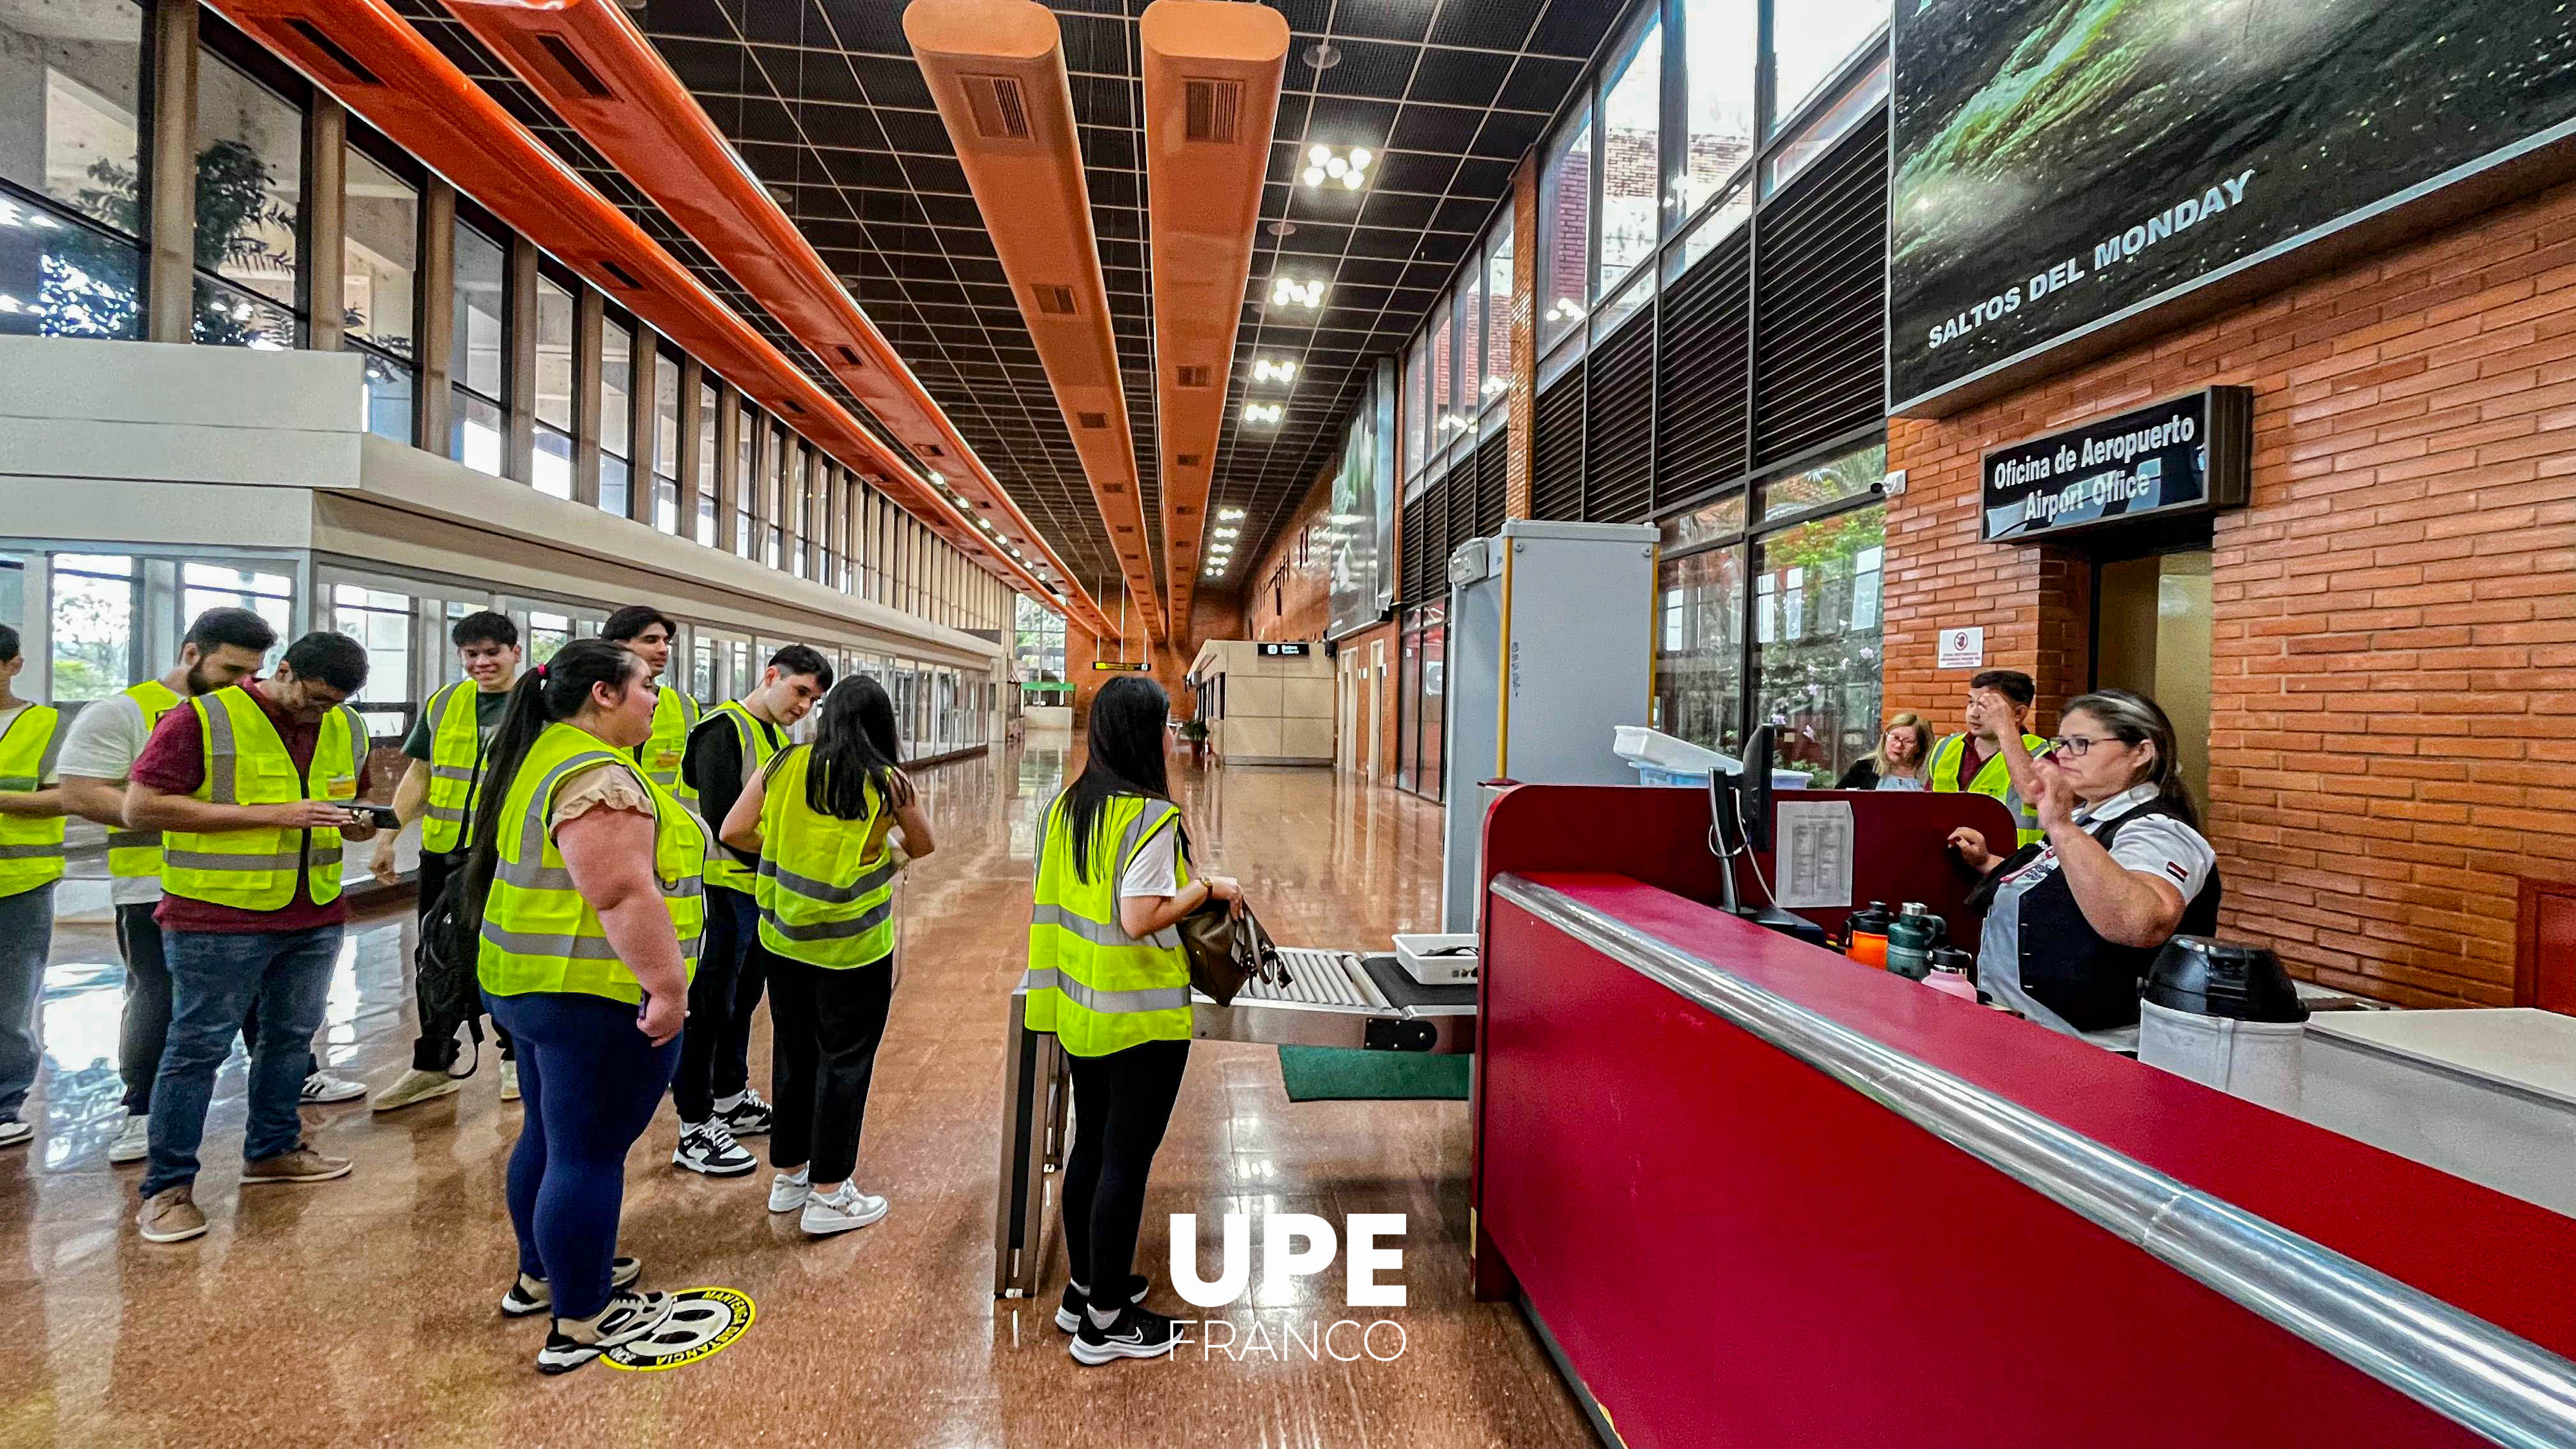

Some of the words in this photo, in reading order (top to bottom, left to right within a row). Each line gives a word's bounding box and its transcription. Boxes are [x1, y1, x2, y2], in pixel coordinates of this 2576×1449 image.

[1929, 286, 2021, 349] SALTOS
[2029, 257, 2085, 302] DEL
[2094, 169, 2255, 271] MONDAY
[1994, 455, 2050, 489] Oficina
[2055, 445, 2076, 475] de
[2081, 415, 2195, 468] Aeropuerto
[2025, 486, 2084, 523] Airport
[2092, 469, 2150, 505] Office
[702, 1291, 747, 1326] MANTENGA
[656, 1326, 740, 1365] DISTANCIA
